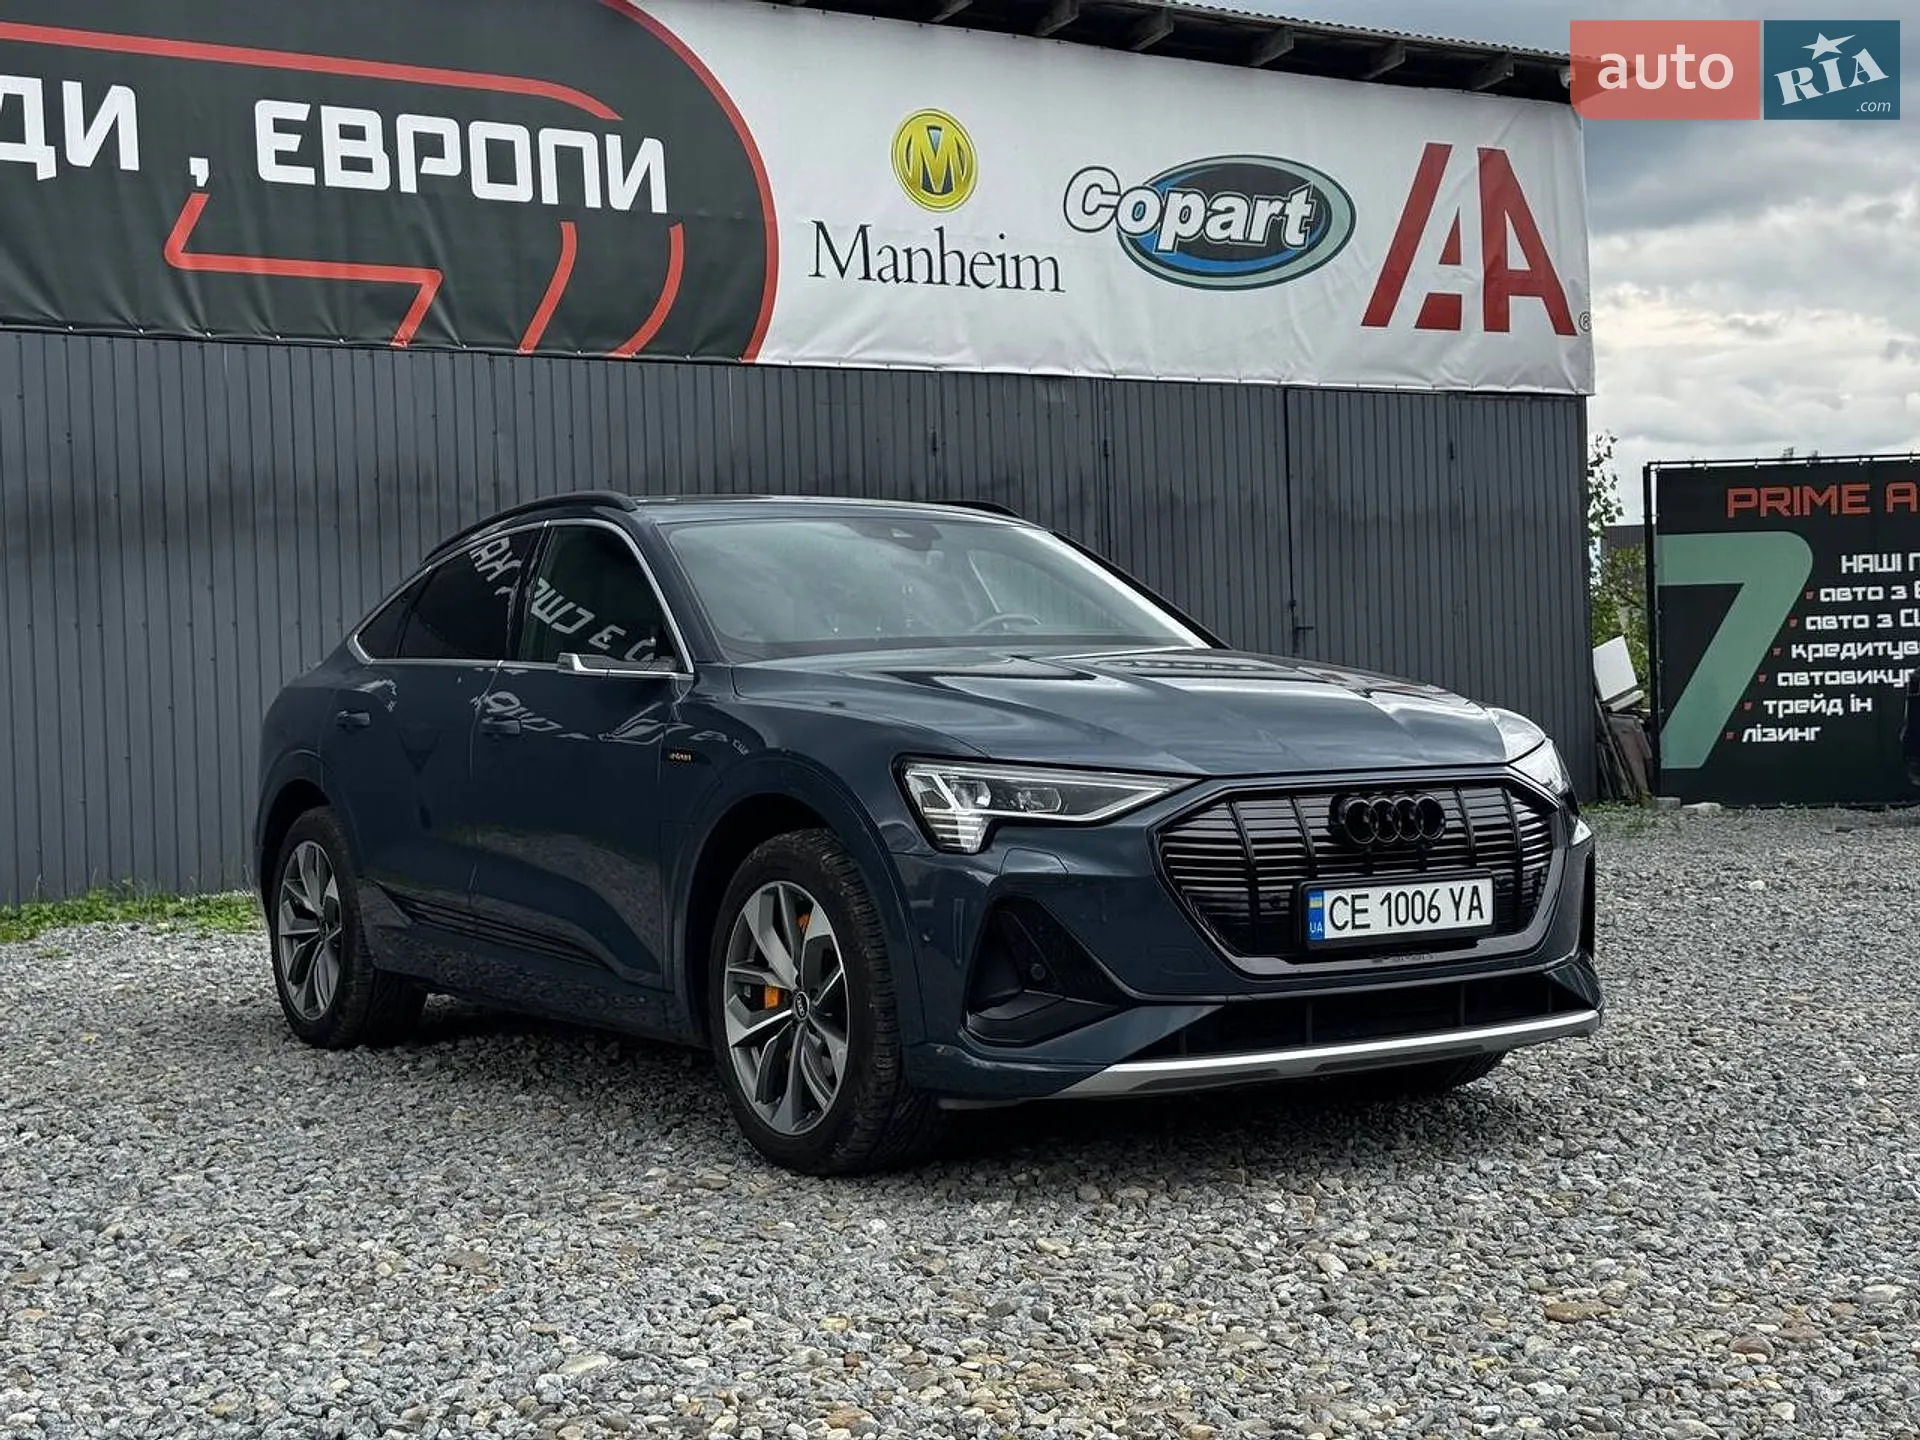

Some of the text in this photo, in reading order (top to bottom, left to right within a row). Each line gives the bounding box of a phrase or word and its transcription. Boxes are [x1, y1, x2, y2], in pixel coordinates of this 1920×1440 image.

[1063, 165, 1317, 253] Copart
[807, 219, 1066, 294] Manheim
[1727, 484, 1871, 518] PRIME
[1841, 553, 1902, 574] НАШІ
[1820, 586, 1884, 602] авто
[1805, 614, 1870, 630] авто
[1763, 693, 1873, 718] трейд ін
[1742, 724, 1822, 742] лізинг
[1329, 886, 1484, 931] CE 1006 YA
[1309, 923, 1324, 935] UA
